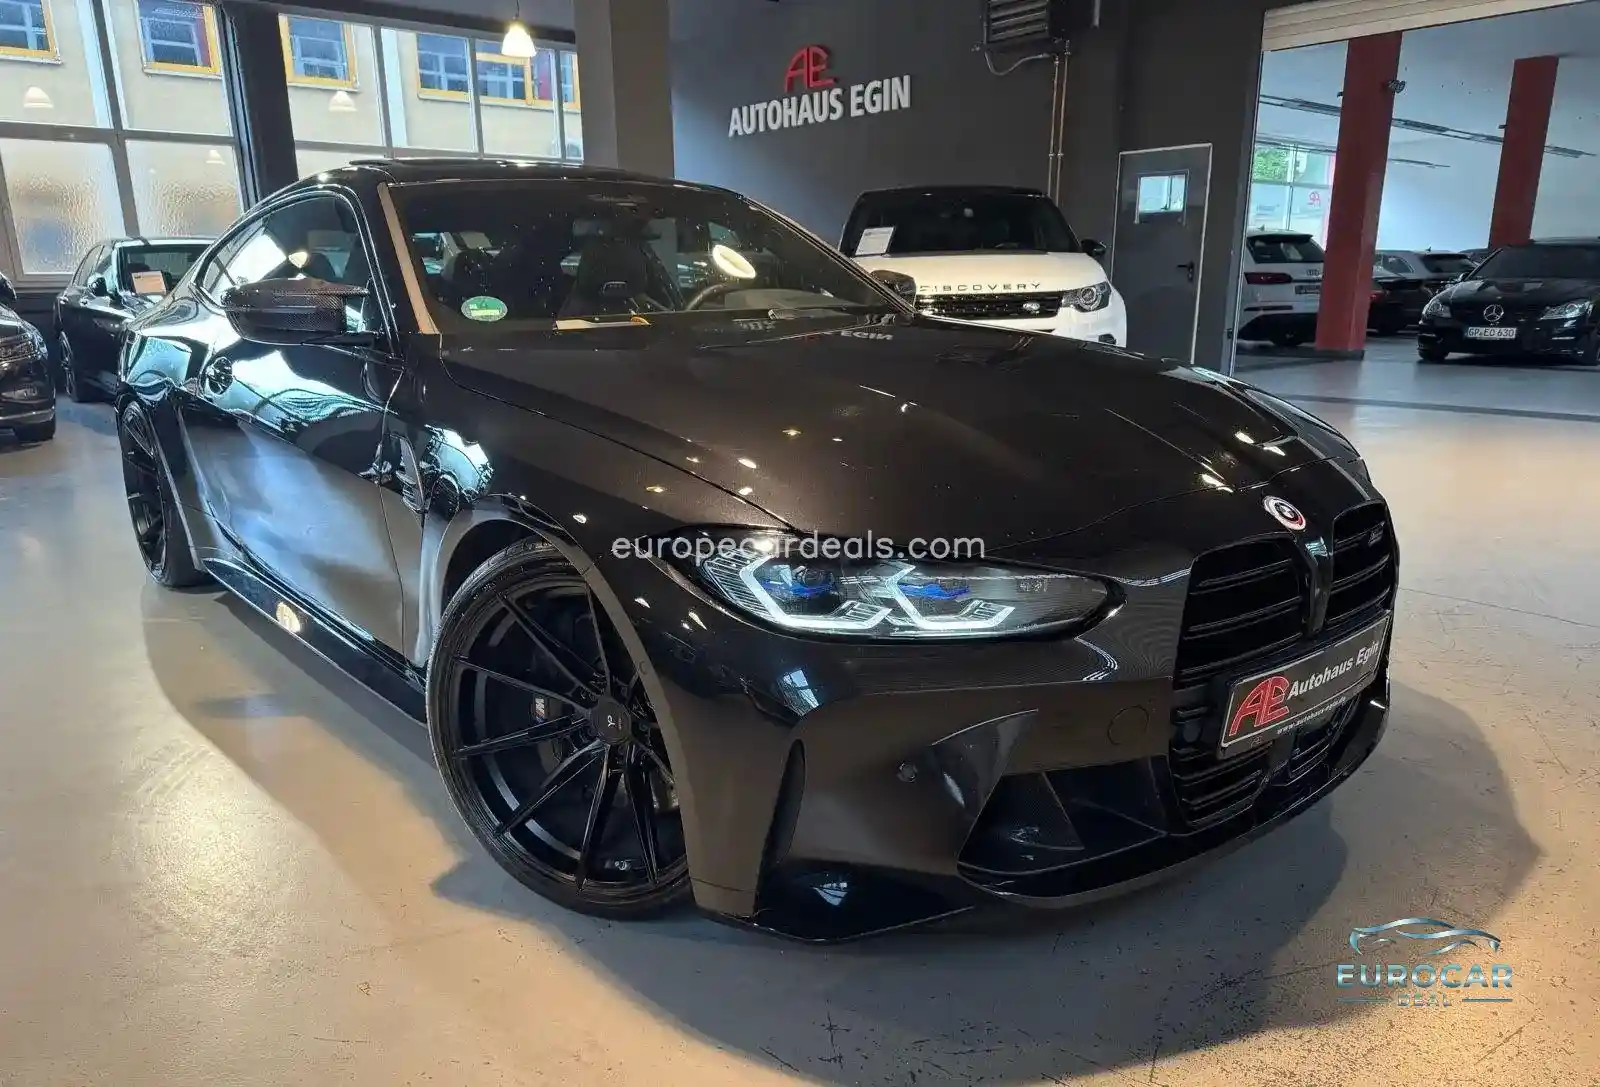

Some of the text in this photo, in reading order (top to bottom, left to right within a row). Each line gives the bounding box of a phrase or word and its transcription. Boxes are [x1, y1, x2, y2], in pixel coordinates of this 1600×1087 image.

[728, 75, 911, 137] AUTOHAUS EGIN
[1287, 640, 1380, 700] Autohaus Egin
